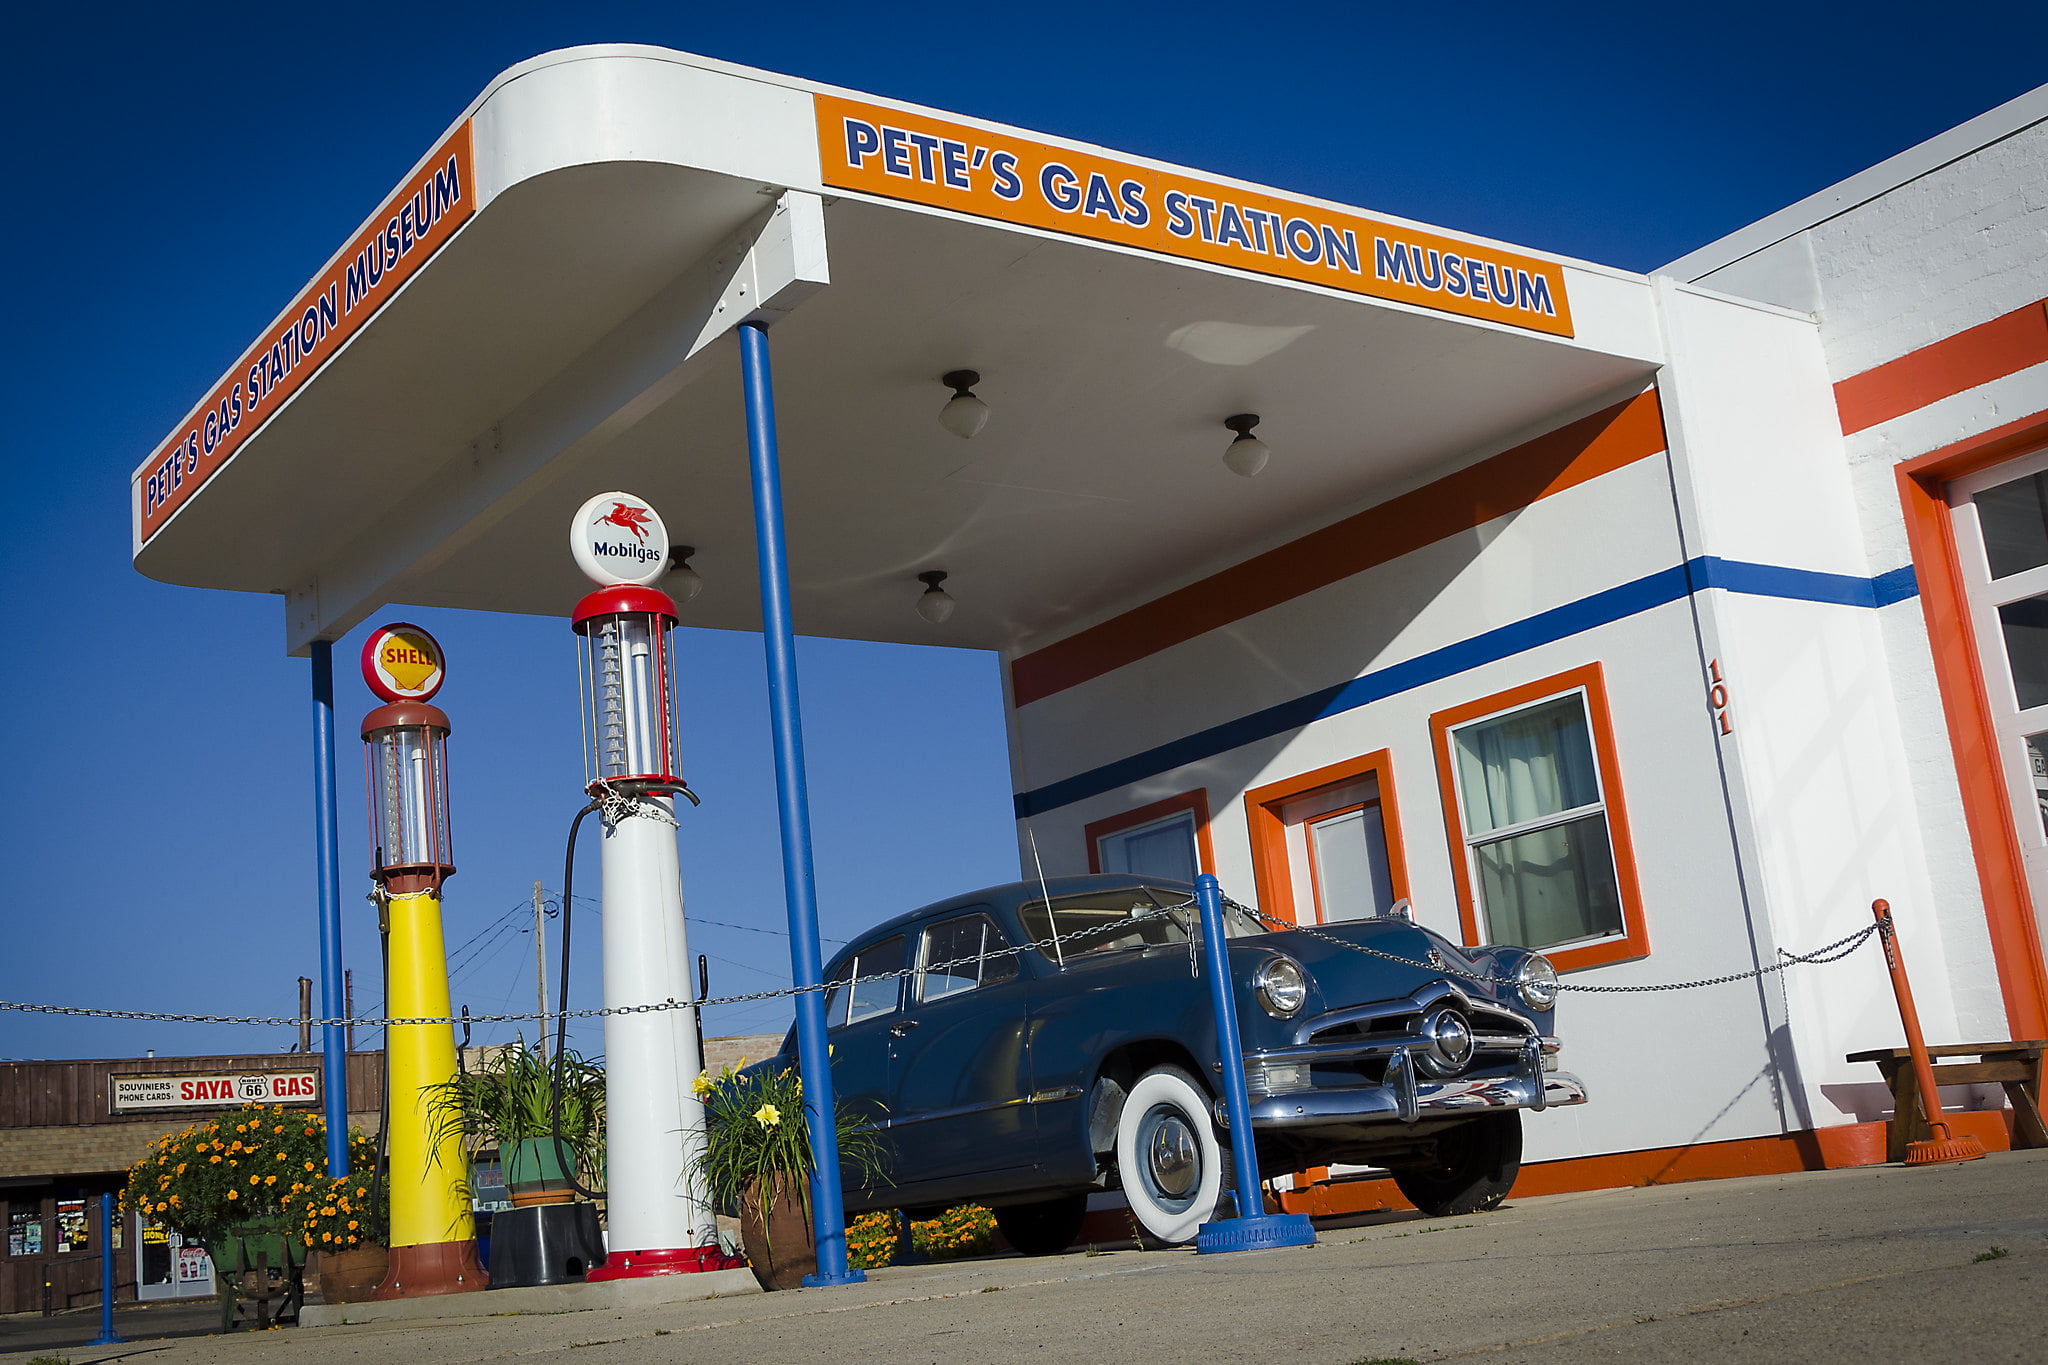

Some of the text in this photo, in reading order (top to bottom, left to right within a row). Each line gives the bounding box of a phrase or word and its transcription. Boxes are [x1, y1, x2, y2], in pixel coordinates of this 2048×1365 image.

[843, 117, 1556, 317] PETE'S GAS STATION MUSEUM
[147, 153, 461, 518] PETE'S GAS STATION MUSEUM
[594, 541, 660, 564] Mobilgas
[386, 648, 433, 667] SHELL
[1708, 658, 1733, 737] 101
[180, 1080, 234, 1101] SAYA
[246, 1084, 262, 1097] 66
[273, 1076, 314, 1097] GAS
[119, 1093, 145, 1102] PHONE
[479, 1171, 504, 1186] OPE
